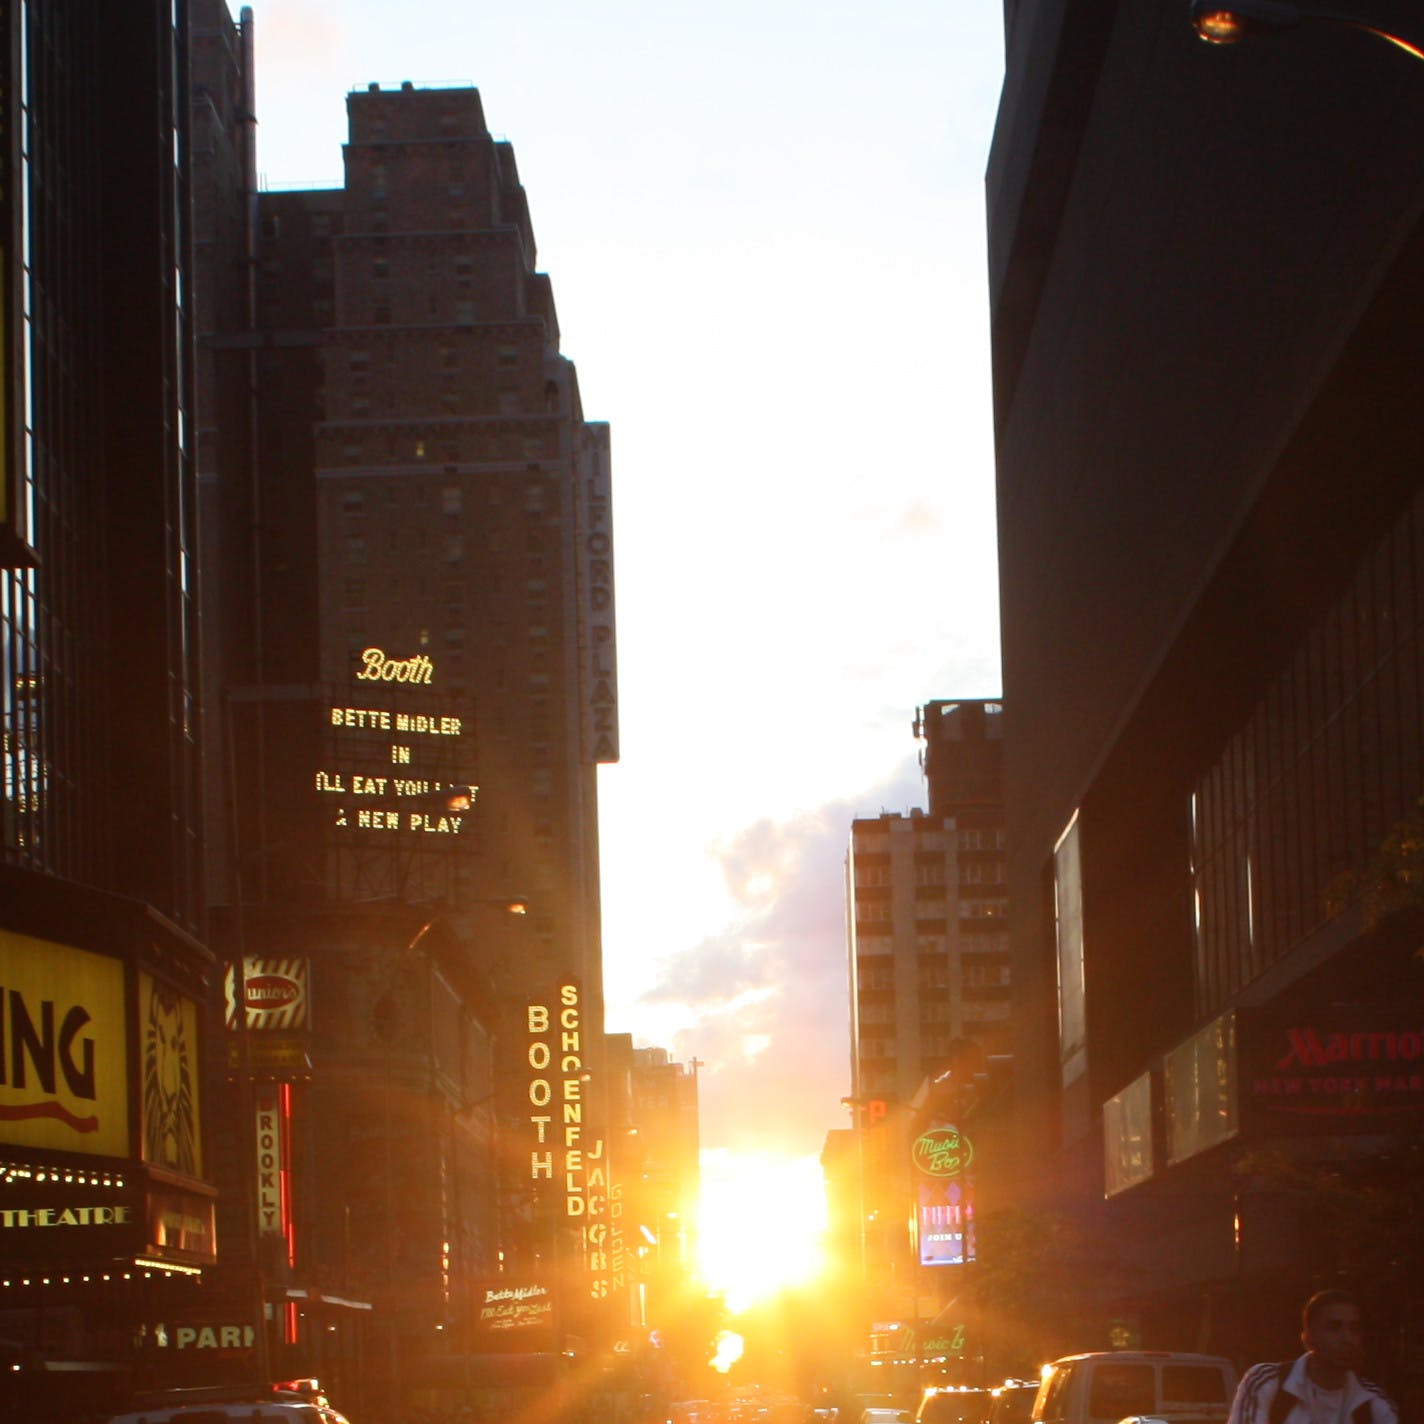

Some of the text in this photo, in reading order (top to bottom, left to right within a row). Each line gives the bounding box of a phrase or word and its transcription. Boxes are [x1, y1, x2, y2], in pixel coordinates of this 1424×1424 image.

[582, 425, 614, 760] MILFORD PLAZA
[356, 647, 434, 685] Booth
[331, 708, 462, 736] BETTE MIDLER
[391, 744, 411, 764] IN
[315, 771, 346, 793] I'LL
[352, 776, 388, 796] EAT
[358, 809, 400, 830] NEW
[410, 813, 463, 834] PLAY
[527, 1005, 552, 1179] BOOTH
[559, 985, 585, 1216] SCHOENFELD
[587, 1139, 608, 1299] JACOBS
